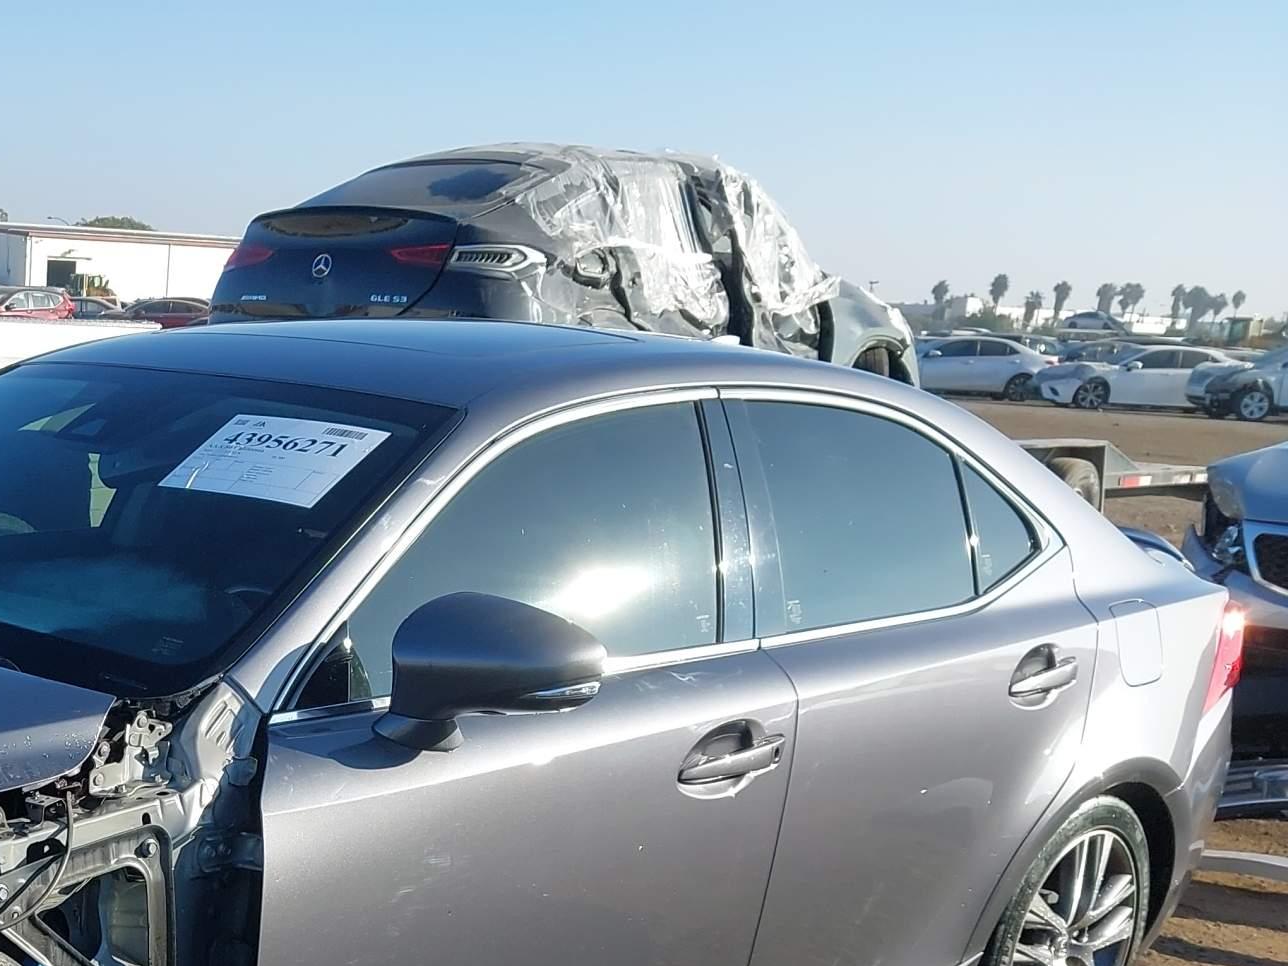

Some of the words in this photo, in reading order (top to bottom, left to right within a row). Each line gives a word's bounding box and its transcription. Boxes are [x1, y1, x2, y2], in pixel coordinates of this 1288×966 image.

[370, 294, 391, 303] GLE
[392, 295, 408, 303] 53
[223, 431, 349, 457] 43956271
